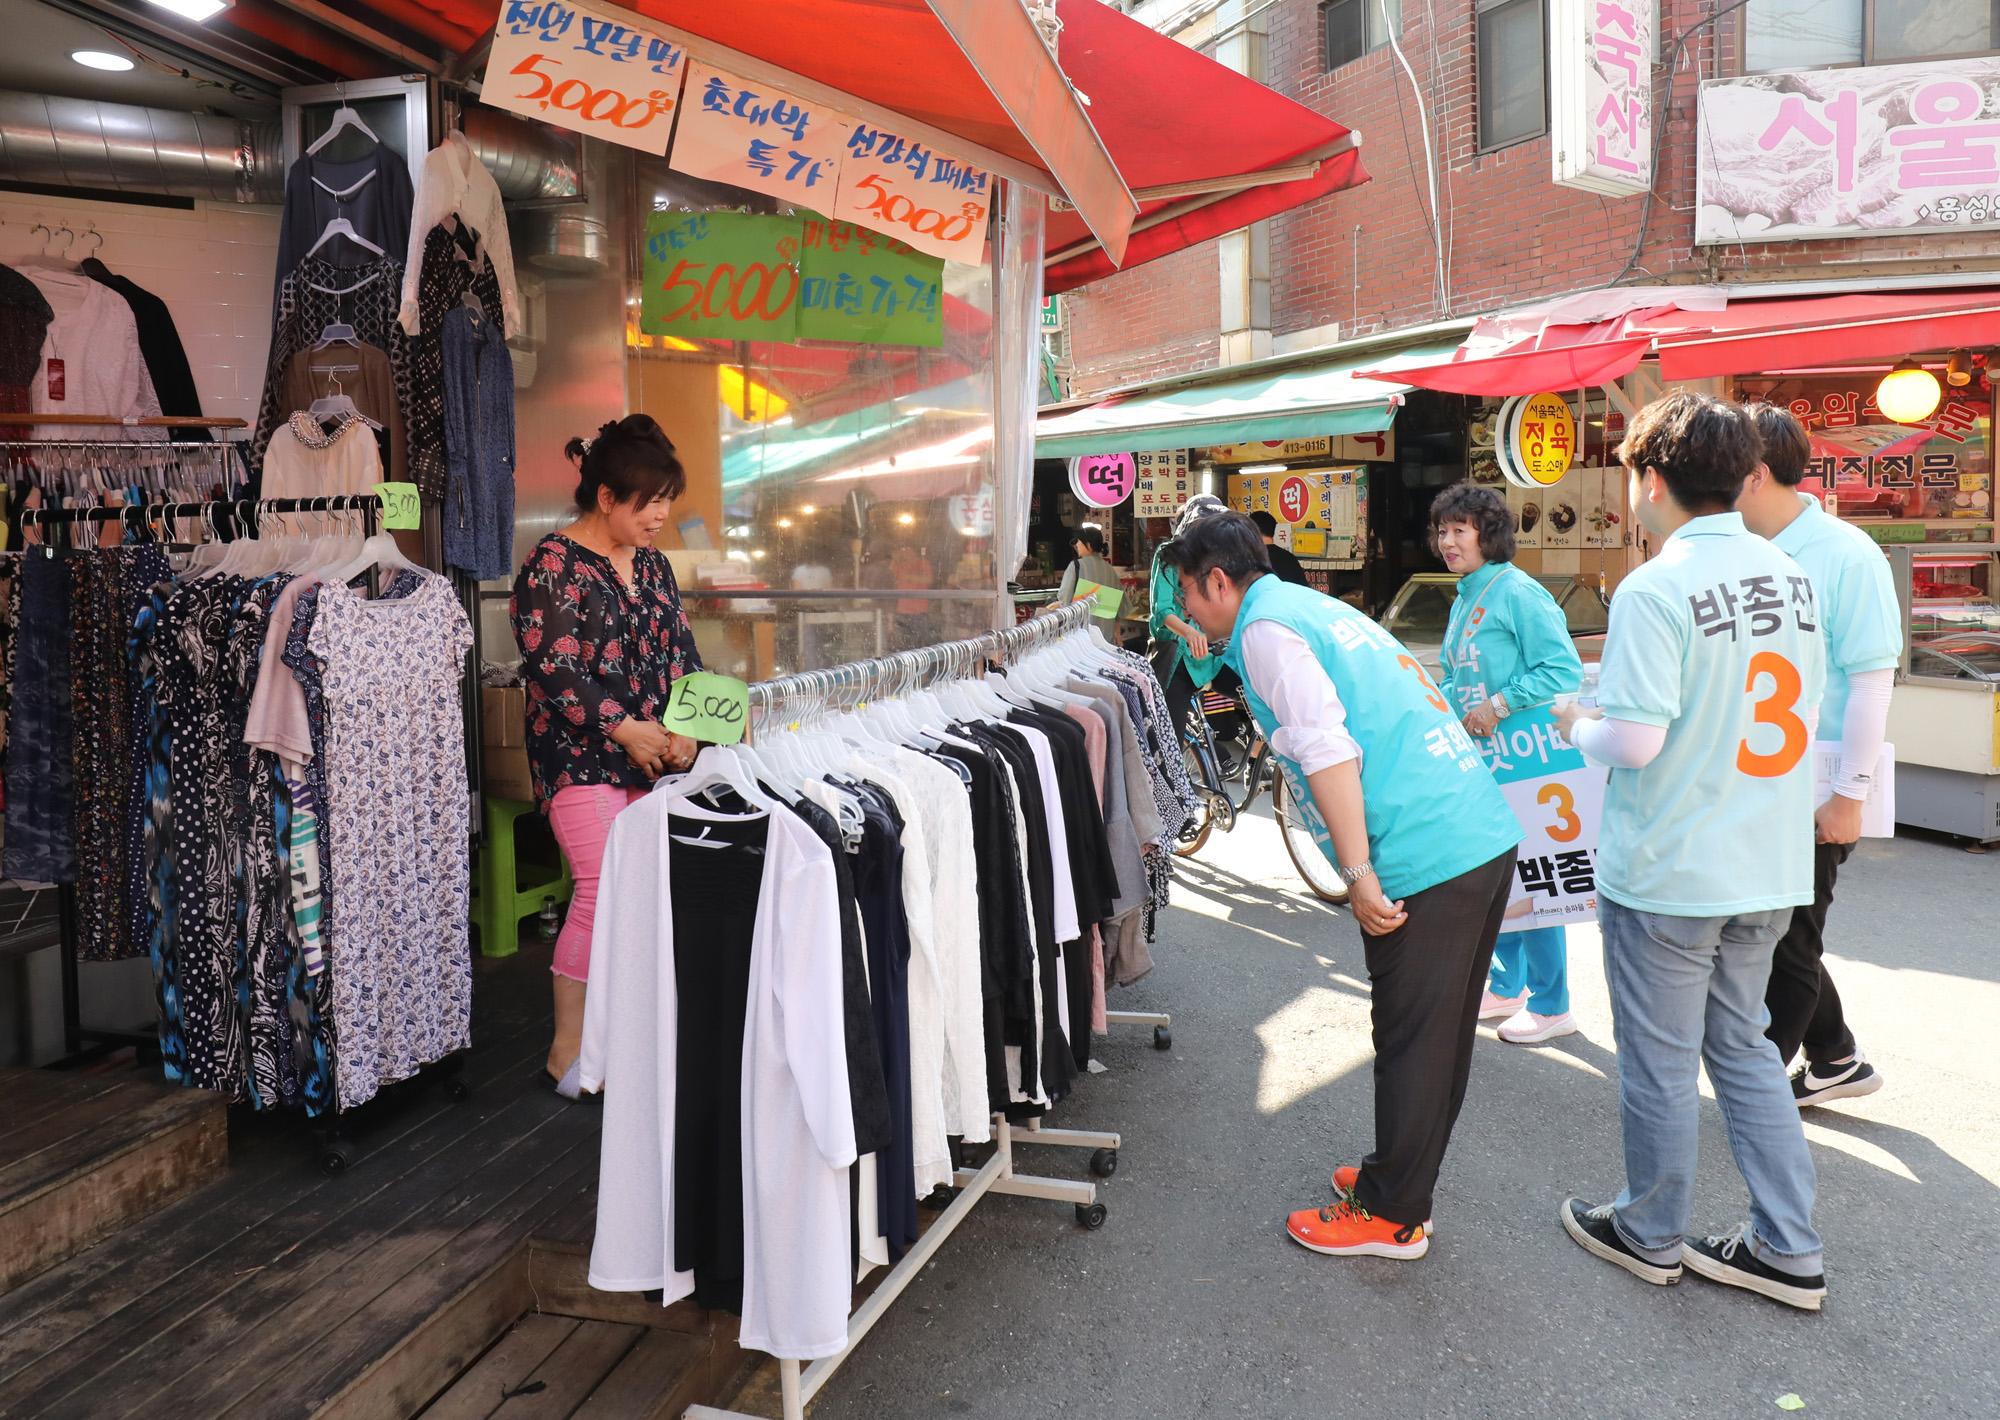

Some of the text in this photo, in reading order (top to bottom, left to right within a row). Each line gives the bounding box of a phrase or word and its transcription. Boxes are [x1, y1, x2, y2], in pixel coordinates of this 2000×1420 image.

[702, 77, 809, 141] 초대박
[1758, 81, 2000, 192] 서울
[1529, 404, 1565, 419] 서울축산
[1284, 440, 1326, 454] 413-0116
[1525, 422, 1570, 457] 정육
[1088, 463, 1123, 497] 떡
[1283, 483, 1301, 518] 떡
[1688, 575, 1816, 642] 박종진
[1397, 654, 1450, 713] 3
[1736, 651, 1809, 778] 3
[1537, 783, 1582, 843] 3
[1517, 848, 1598, 897] 박종
